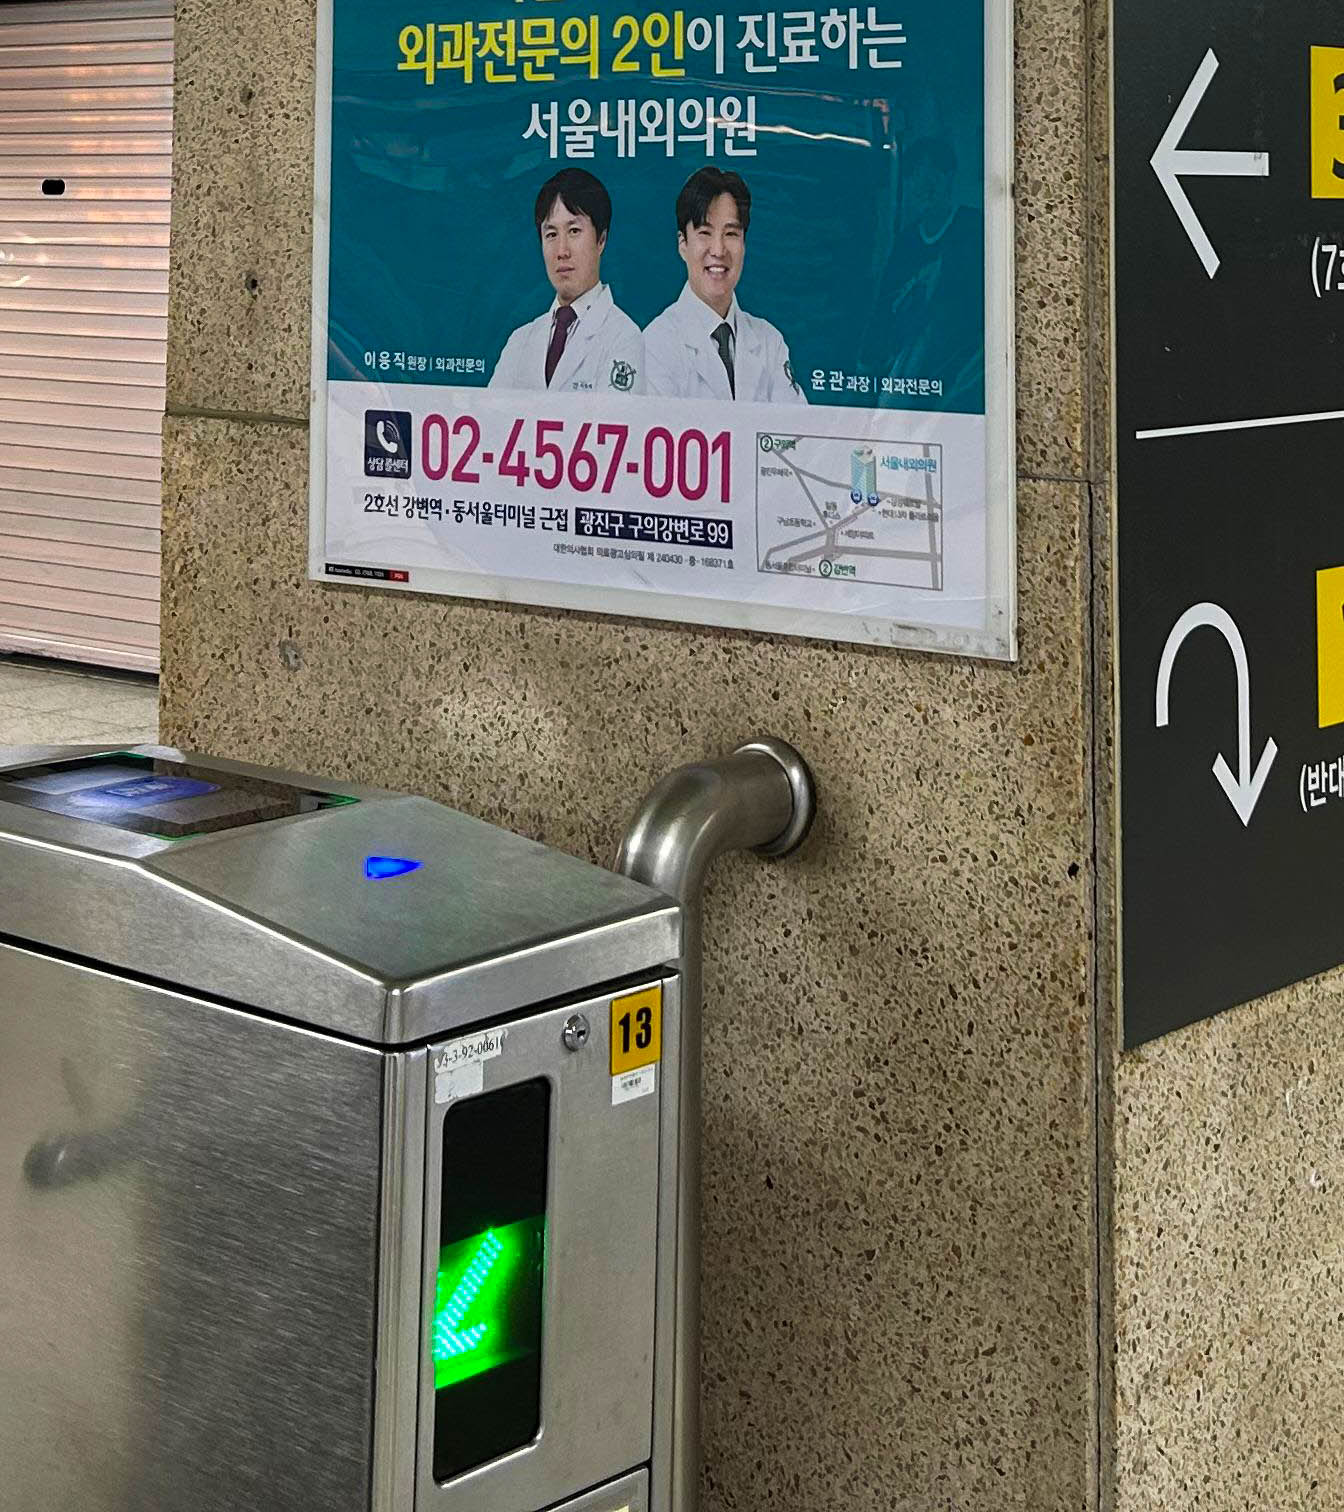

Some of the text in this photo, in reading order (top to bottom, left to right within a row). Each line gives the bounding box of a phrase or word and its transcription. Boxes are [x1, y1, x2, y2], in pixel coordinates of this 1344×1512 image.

[397, 6, 907, 84] 외과전문의 2인이 진료하는
[522, 94, 758, 158] 서울내외의원
[420, 413, 732, 503] 02-4567-001
[364, 493, 399, 517] 2호선
[539, 506, 569, 532] 근접
[580, 510, 729, 545] 광진구 구의강변로 99
[618, 1006, 652, 1054] 13
